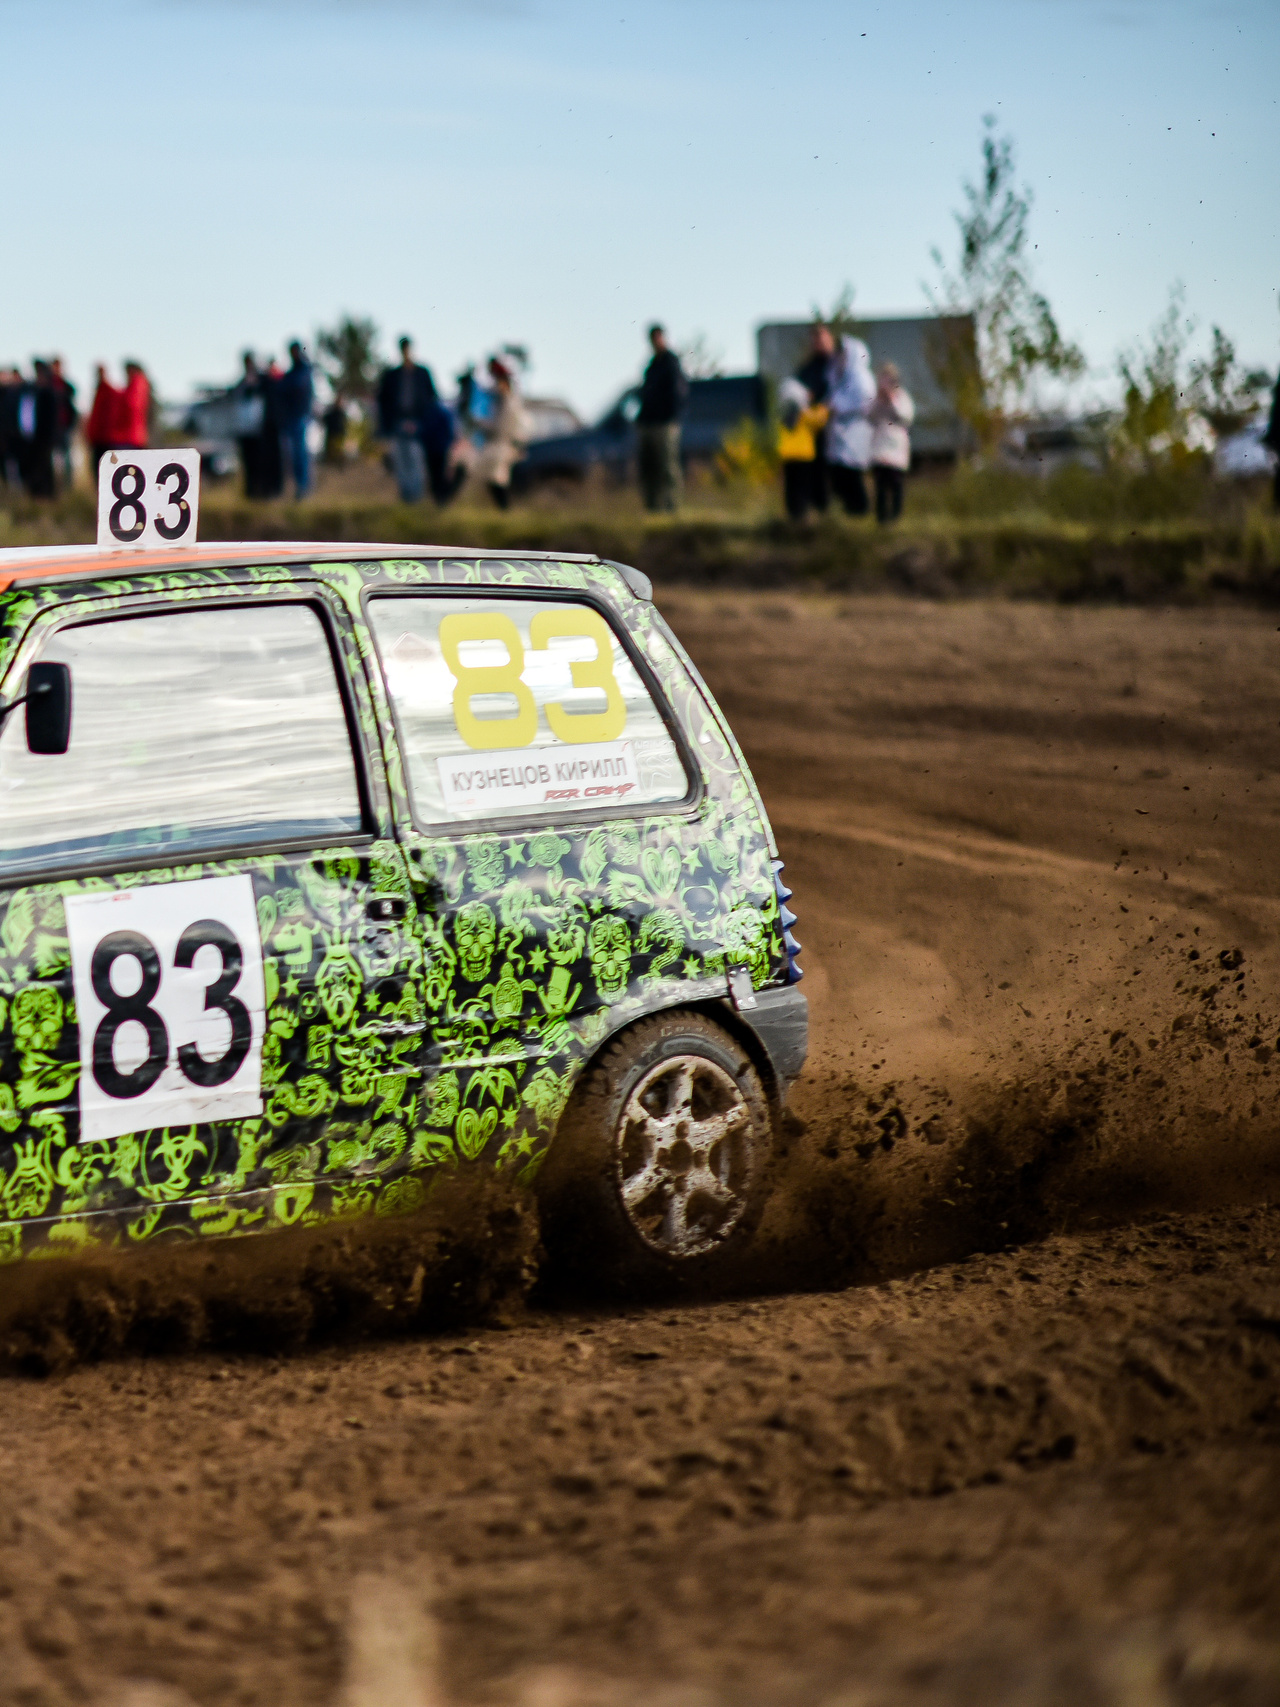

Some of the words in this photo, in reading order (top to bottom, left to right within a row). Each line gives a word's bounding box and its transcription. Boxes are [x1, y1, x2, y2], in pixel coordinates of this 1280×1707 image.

[109, 463, 191, 542] 83
[438, 608, 627, 749] 83
[451, 763, 552, 792] КУЗНЕЦОВ
[555, 756, 628, 782] КИРИЛЛ
[91, 918, 252, 1099] 83
